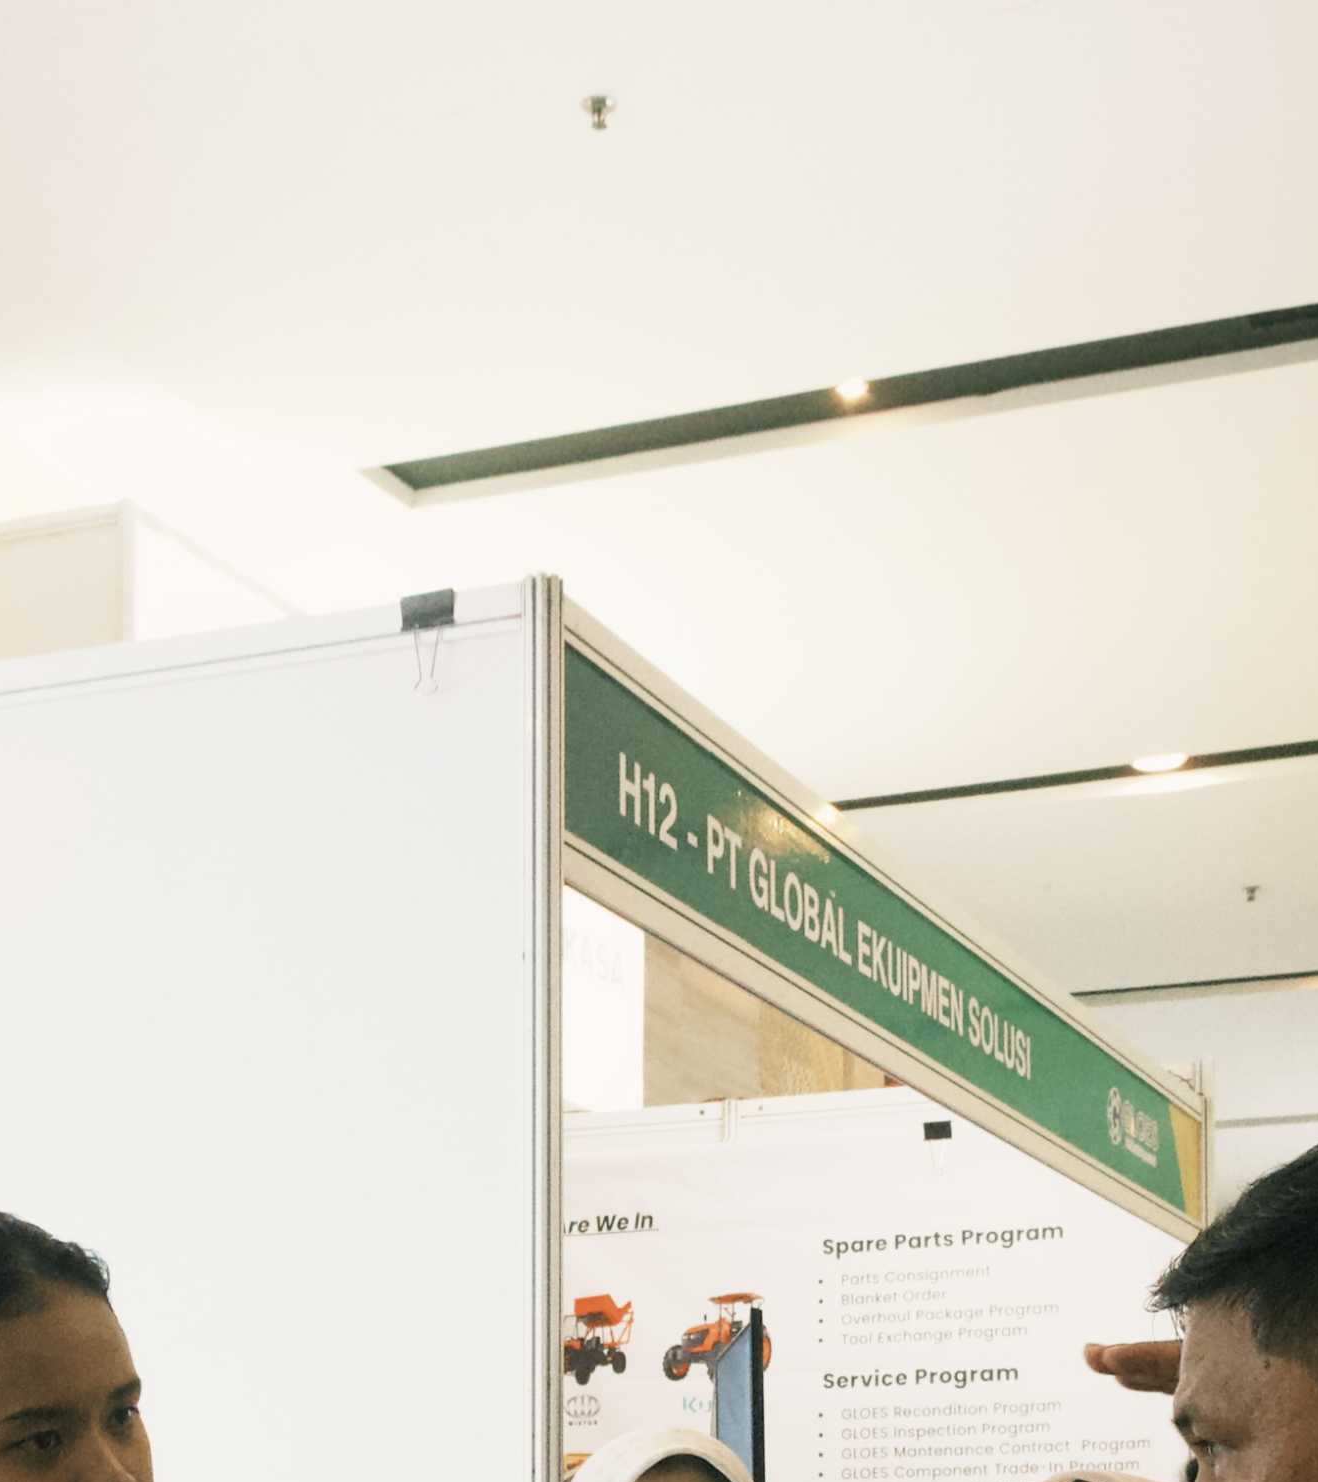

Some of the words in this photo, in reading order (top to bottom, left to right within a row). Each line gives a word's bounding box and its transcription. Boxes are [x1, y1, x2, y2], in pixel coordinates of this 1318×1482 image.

[618, 752, 678, 851] H12
[706, 814, 743, 891] PT
[748, 847, 852, 967] GLOBAL
[857, 919, 964, 1038] EKUIPMEN
[968, 992, 1032, 1081] SOLUSI
[596, 1215, 629, 1233] We
[634, 1212, 654, 1230] In
[823, 1238, 887, 1259] Spare
[894, 1233, 954, 1251] Parts
[961, 1225, 1064, 1248] Program
[841, 1273, 880, 1286] Parts
[885, 1265, 990, 1283] Consignment
[841, 1291, 898, 1305] Blanket
[903, 1289, 947, 1303] Order
[916, 1307, 984, 1323] Package
[989, 1302, 1060, 1319] Program
[841, 1332, 873, 1346] Tool
[878, 1329, 953, 1345] Exchange
[958, 1324, 1028, 1341] Program
[823, 1369, 908, 1389] Service
[915, 1366, 1020, 1389] Program
[841, 1407, 889, 1421] GLOES
[893, 1402, 988, 1419] Recondition
[993, 1400, 1063, 1417] Program
[841, 1427, 889, 1441] GLOES
[893, 1423, 977, 1440] Inspection
[982, 1420, 1052, 1437] Program
[841, 1447, 889, 1461] GLOES
[999, 1440, 1071, 1455] Contract
[1082, 1437, 1152, 1454] Program
[841, 1466, 889, 1481] GLOES
[893, 1463, 989, 1482] Component
